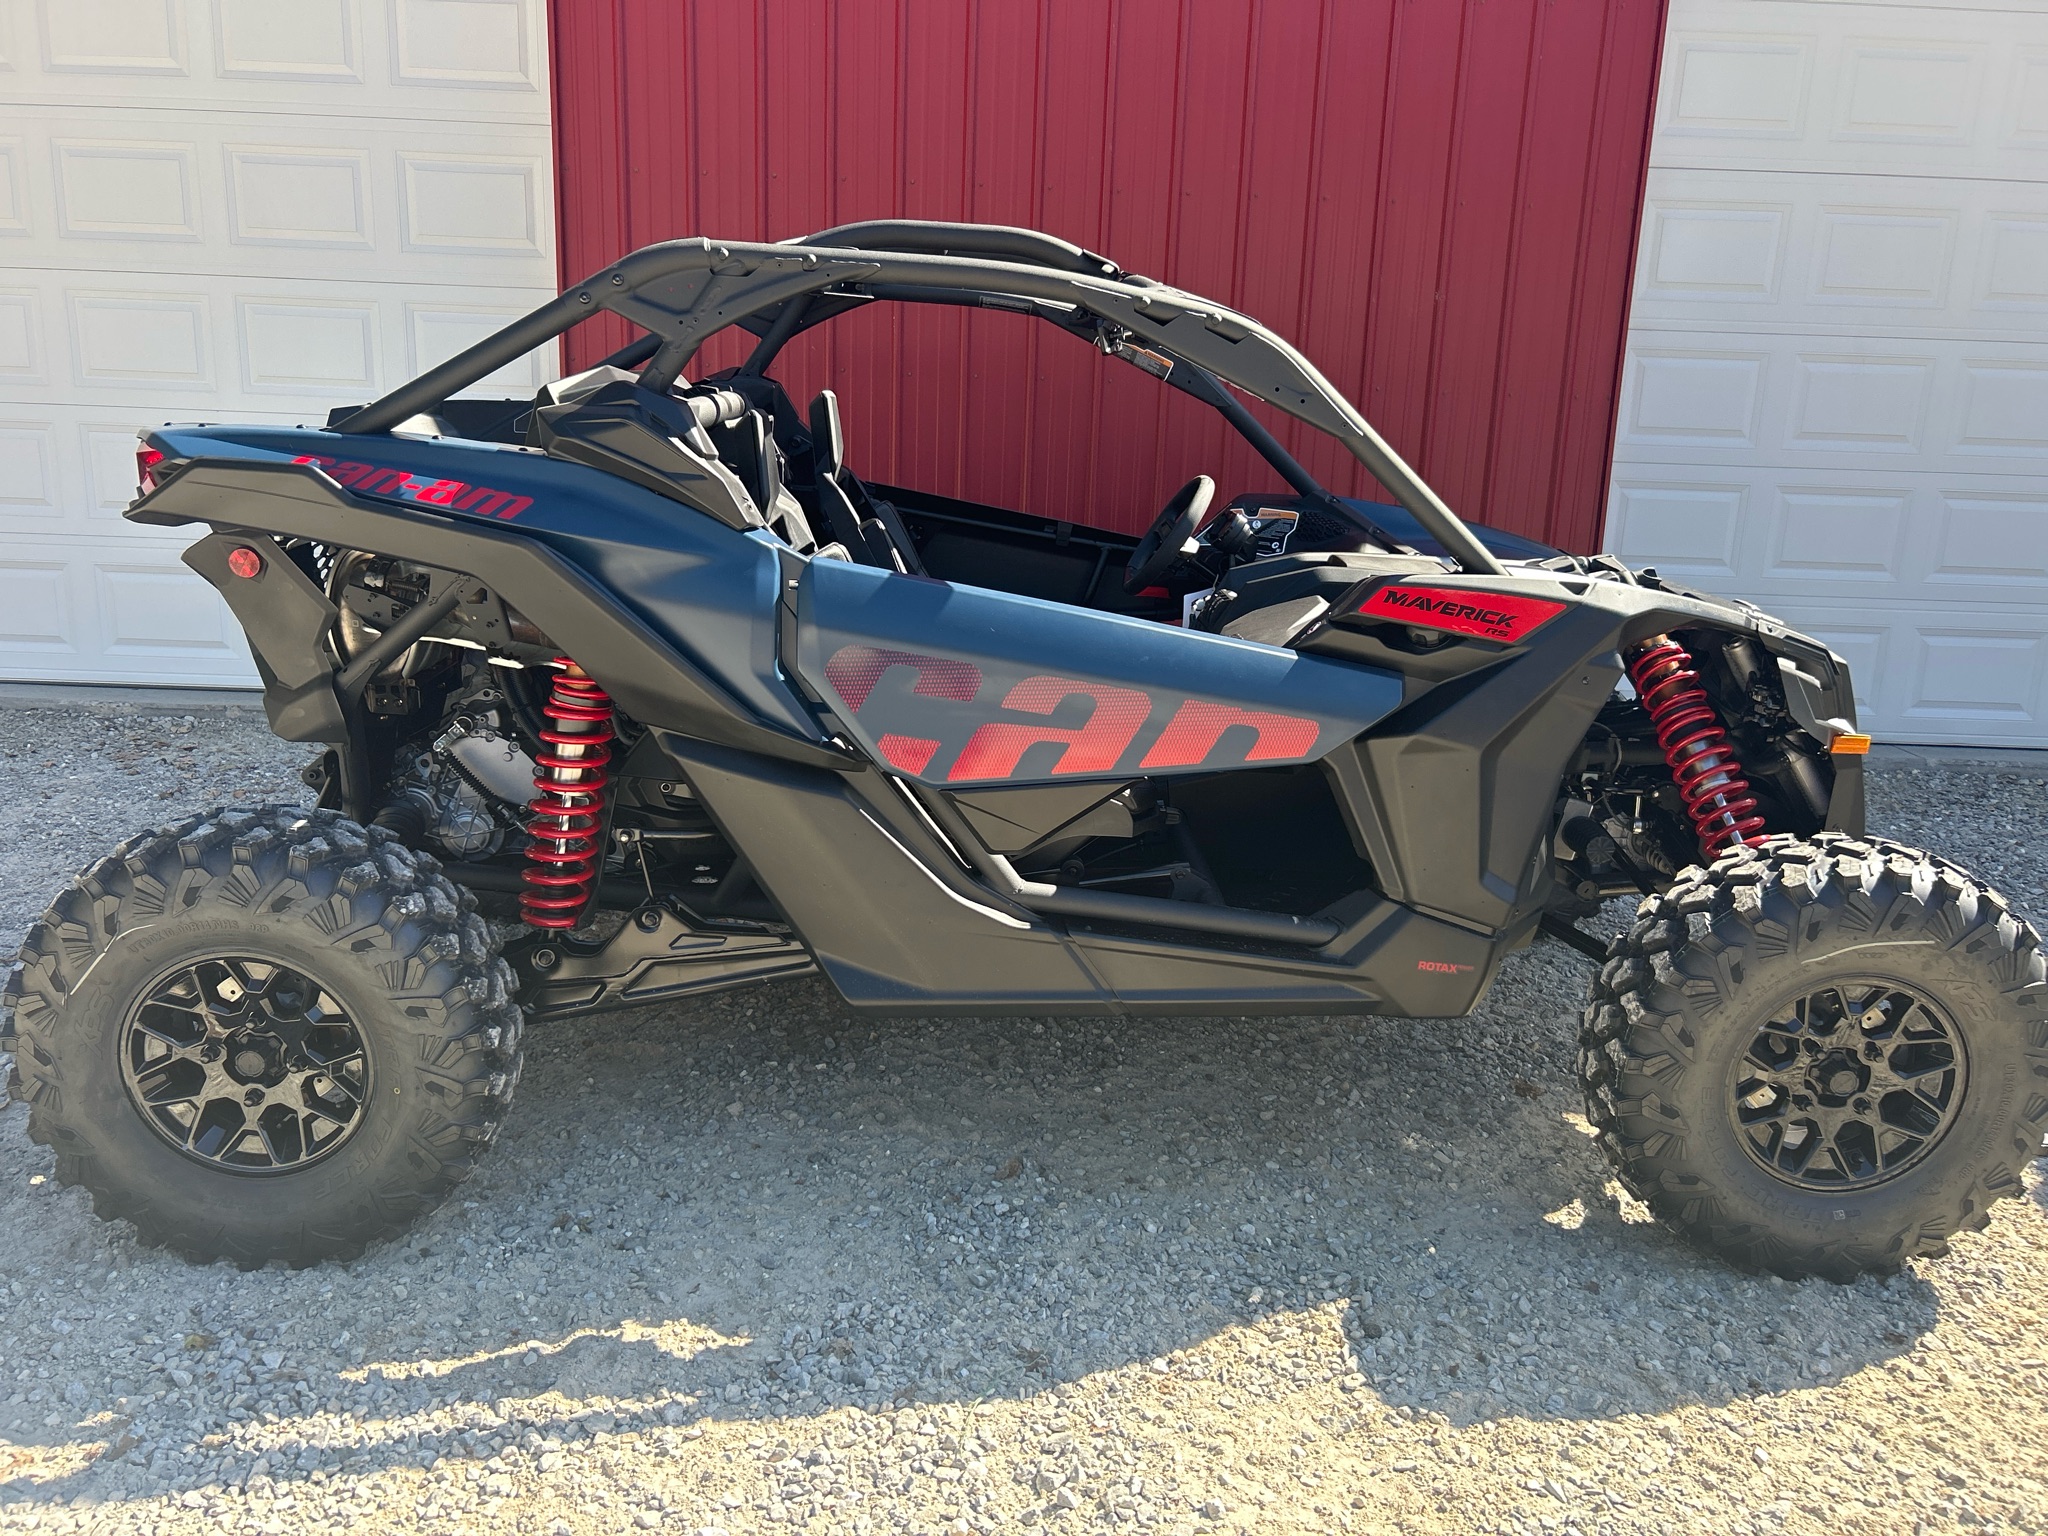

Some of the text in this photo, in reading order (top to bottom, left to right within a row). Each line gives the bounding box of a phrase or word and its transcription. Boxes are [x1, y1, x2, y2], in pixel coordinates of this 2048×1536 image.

[1383, 590, 1519, 629] MAVERICK
[1485, 627, 1512, 638] RS
[1418, 961, 1458, 974] ROTAX
[75, 986, 116, 1058] XPS
